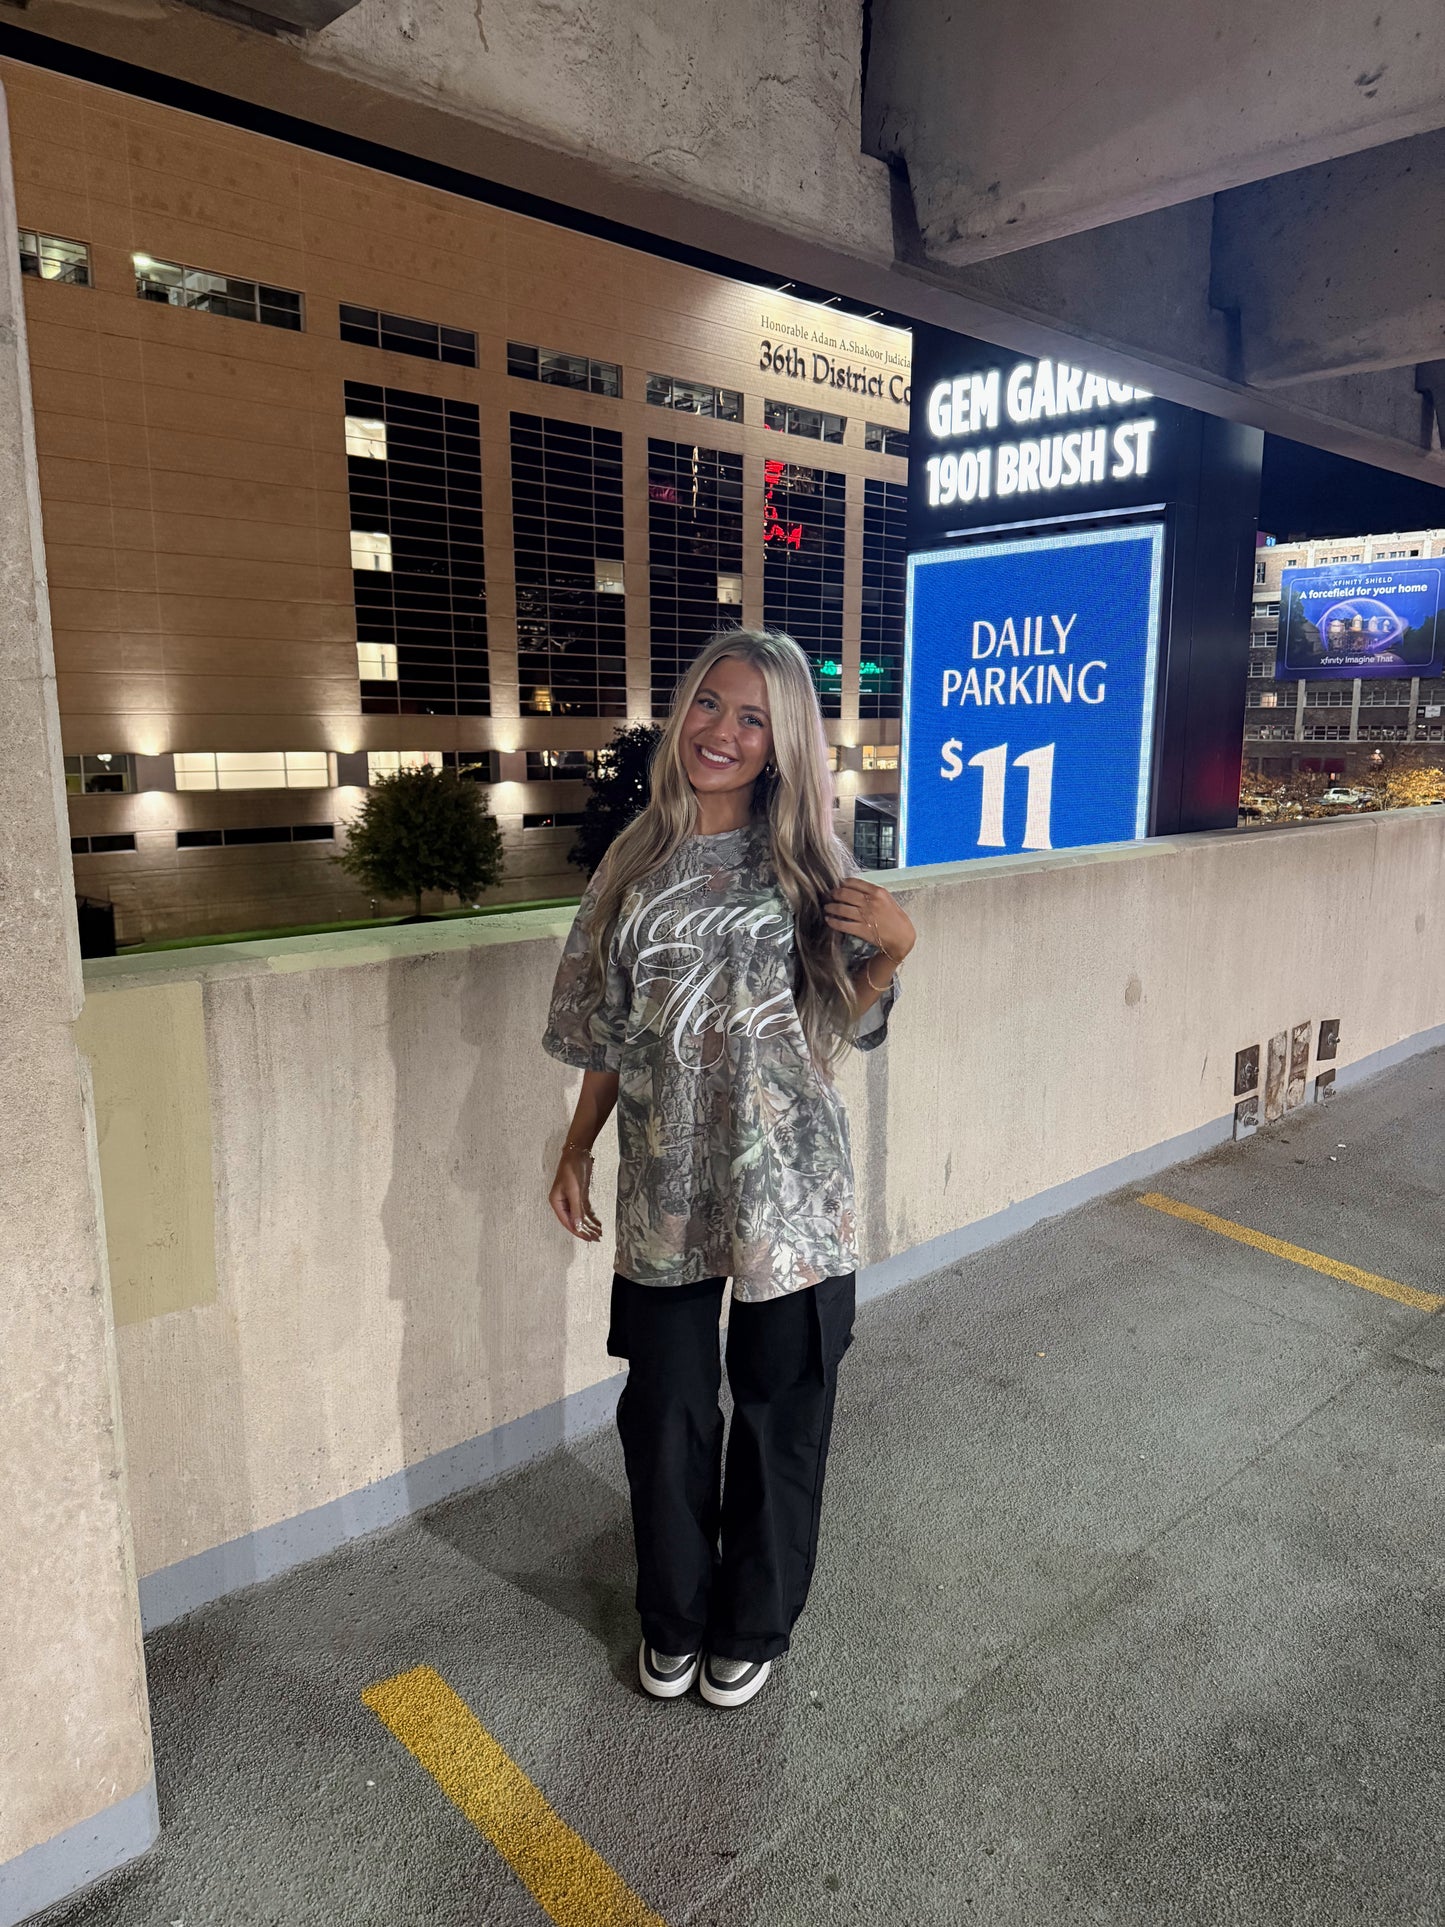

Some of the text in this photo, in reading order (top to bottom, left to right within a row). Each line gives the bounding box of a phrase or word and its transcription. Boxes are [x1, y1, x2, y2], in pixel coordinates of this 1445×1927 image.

[761, 315, 809, 339] Honorable
[811, 331, 837, 348] Adam
[760, 340, 806, 379] 36th
[812, 352, 884, 398] District
[928, 360, 1154, 438] GEM GARA
[927, 420, 1155, 506] 1901 BRUSH ST
[1299, 583, 1428, 600] A forcefield for your home
[1332, 576, 1393, 587] XFINITY SHIELD
[972, 613, 1078, 660] DAILY
[1345, 656, 1375, 665] Imagine
[1377, 655, 1393, 663] That
[941, 660, 1108, 707] PARKING
[940, 737, 1055, 850] $11
[625, 955, 793, 1069] Made
